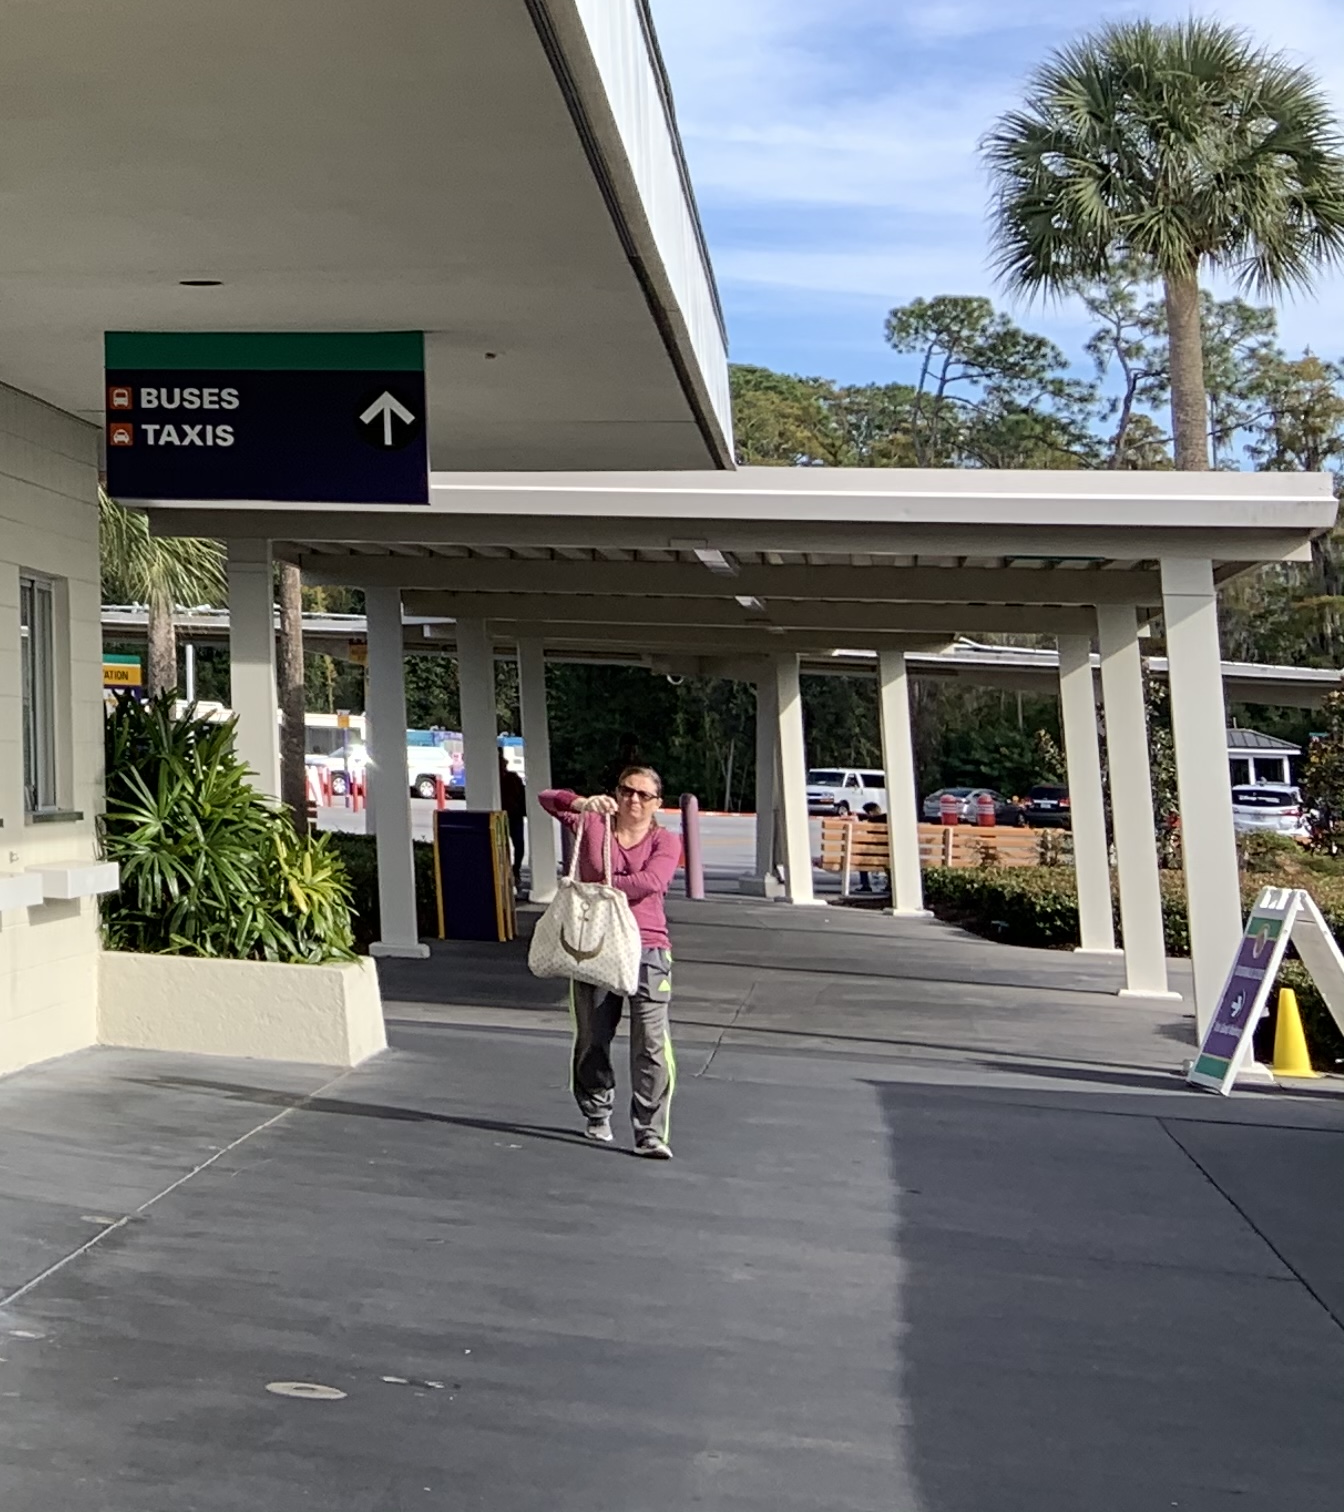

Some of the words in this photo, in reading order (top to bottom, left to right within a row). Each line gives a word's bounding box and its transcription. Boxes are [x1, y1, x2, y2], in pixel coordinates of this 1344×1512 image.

[140, 387, 240, 410] BUSES
[141, 423, 235, 447] TAXIS
[104, 670, 129, 680] ATION
